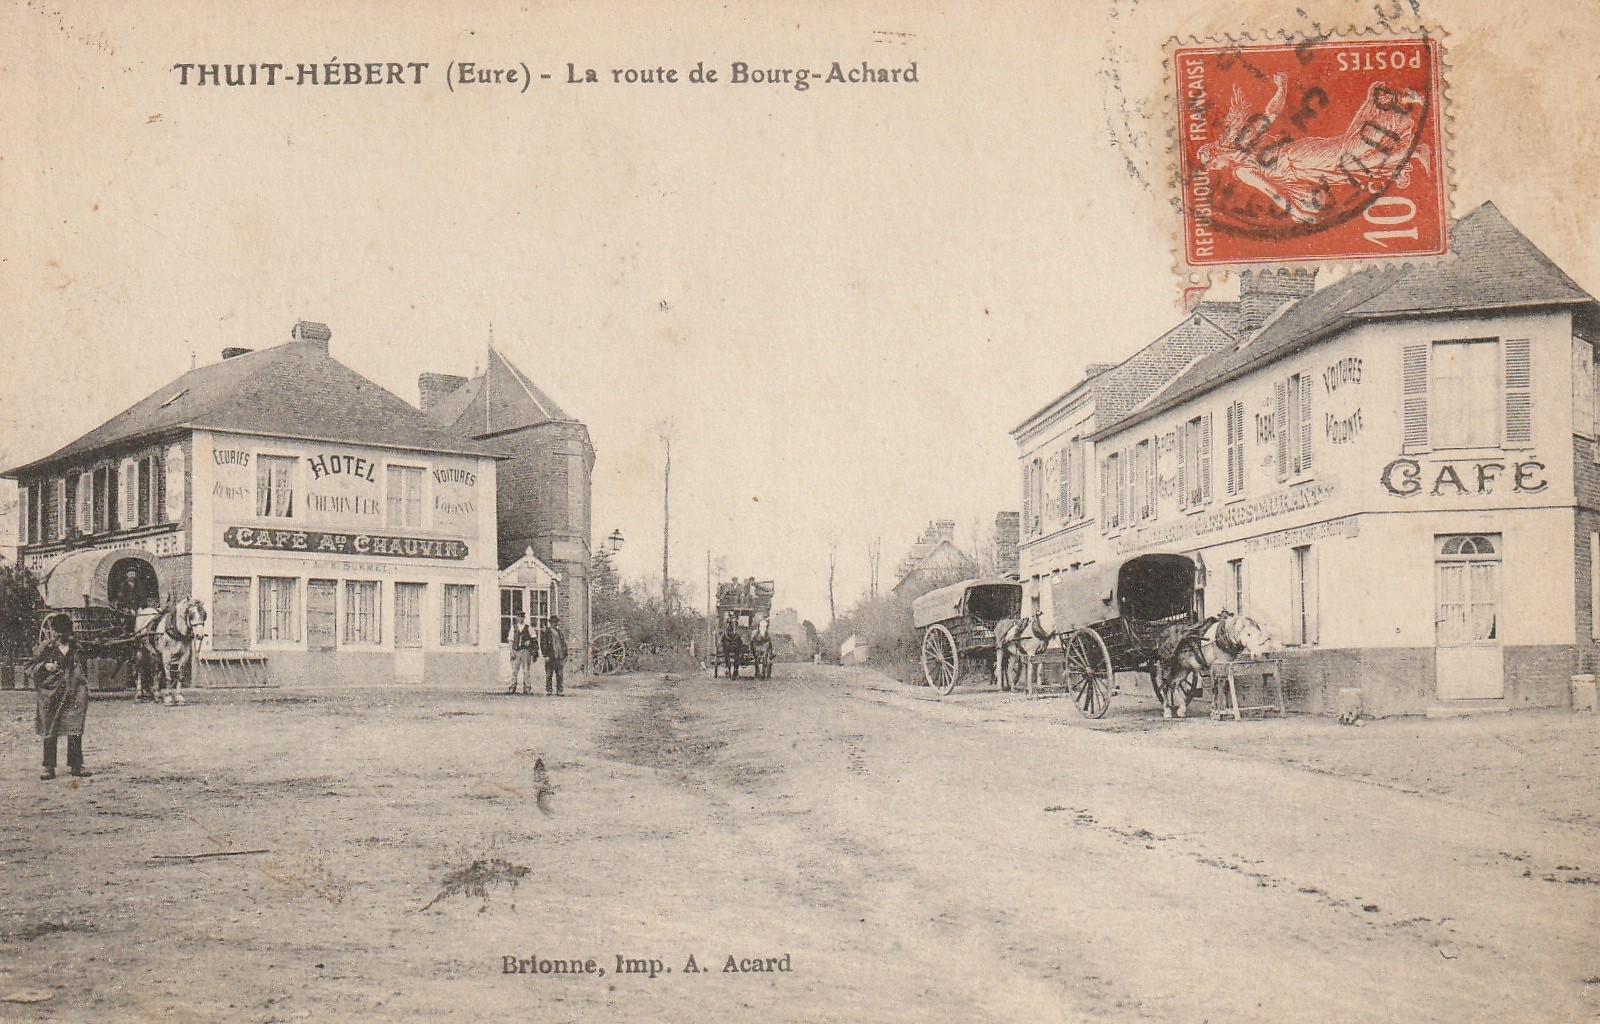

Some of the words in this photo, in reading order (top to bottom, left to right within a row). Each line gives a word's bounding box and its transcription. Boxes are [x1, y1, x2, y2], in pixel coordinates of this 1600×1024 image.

[1337, 50, 1422, 72] POSTES
[1362, 196, 1419, 248] 10
[1322, 356, 1363, 397] VOITURES
[306, 452, 376, 484] HOTEL
[432, 468, 477, 488] VOITURES
[353, 534, 462, 558] CHAUVIN
